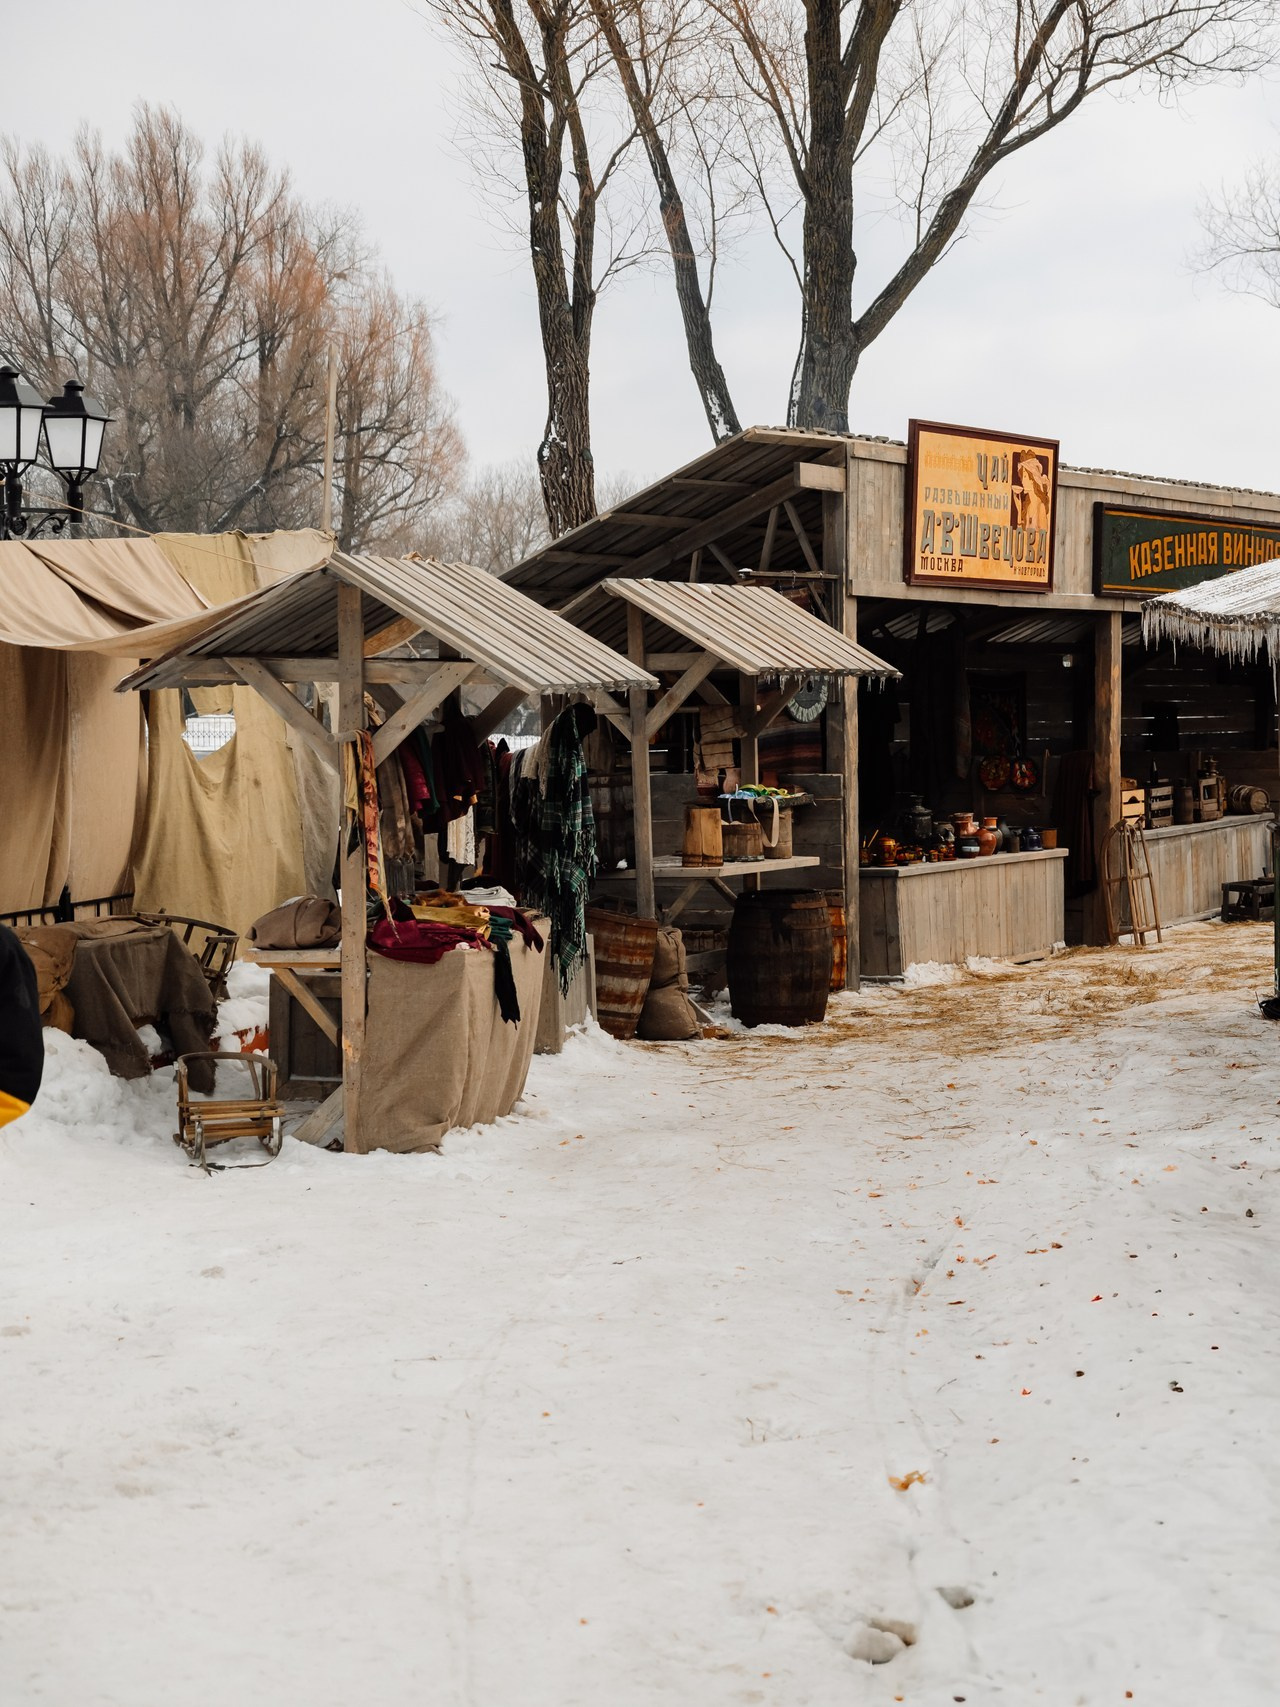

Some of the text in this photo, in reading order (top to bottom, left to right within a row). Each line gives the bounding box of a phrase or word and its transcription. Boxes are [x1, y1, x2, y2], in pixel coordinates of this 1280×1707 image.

[977, 452, 1009, 490] ЧАЙ
[920, 556, 964, 573] МОСКВА
[1129, 532, 1218, 580] КАЗЕННАЯ
